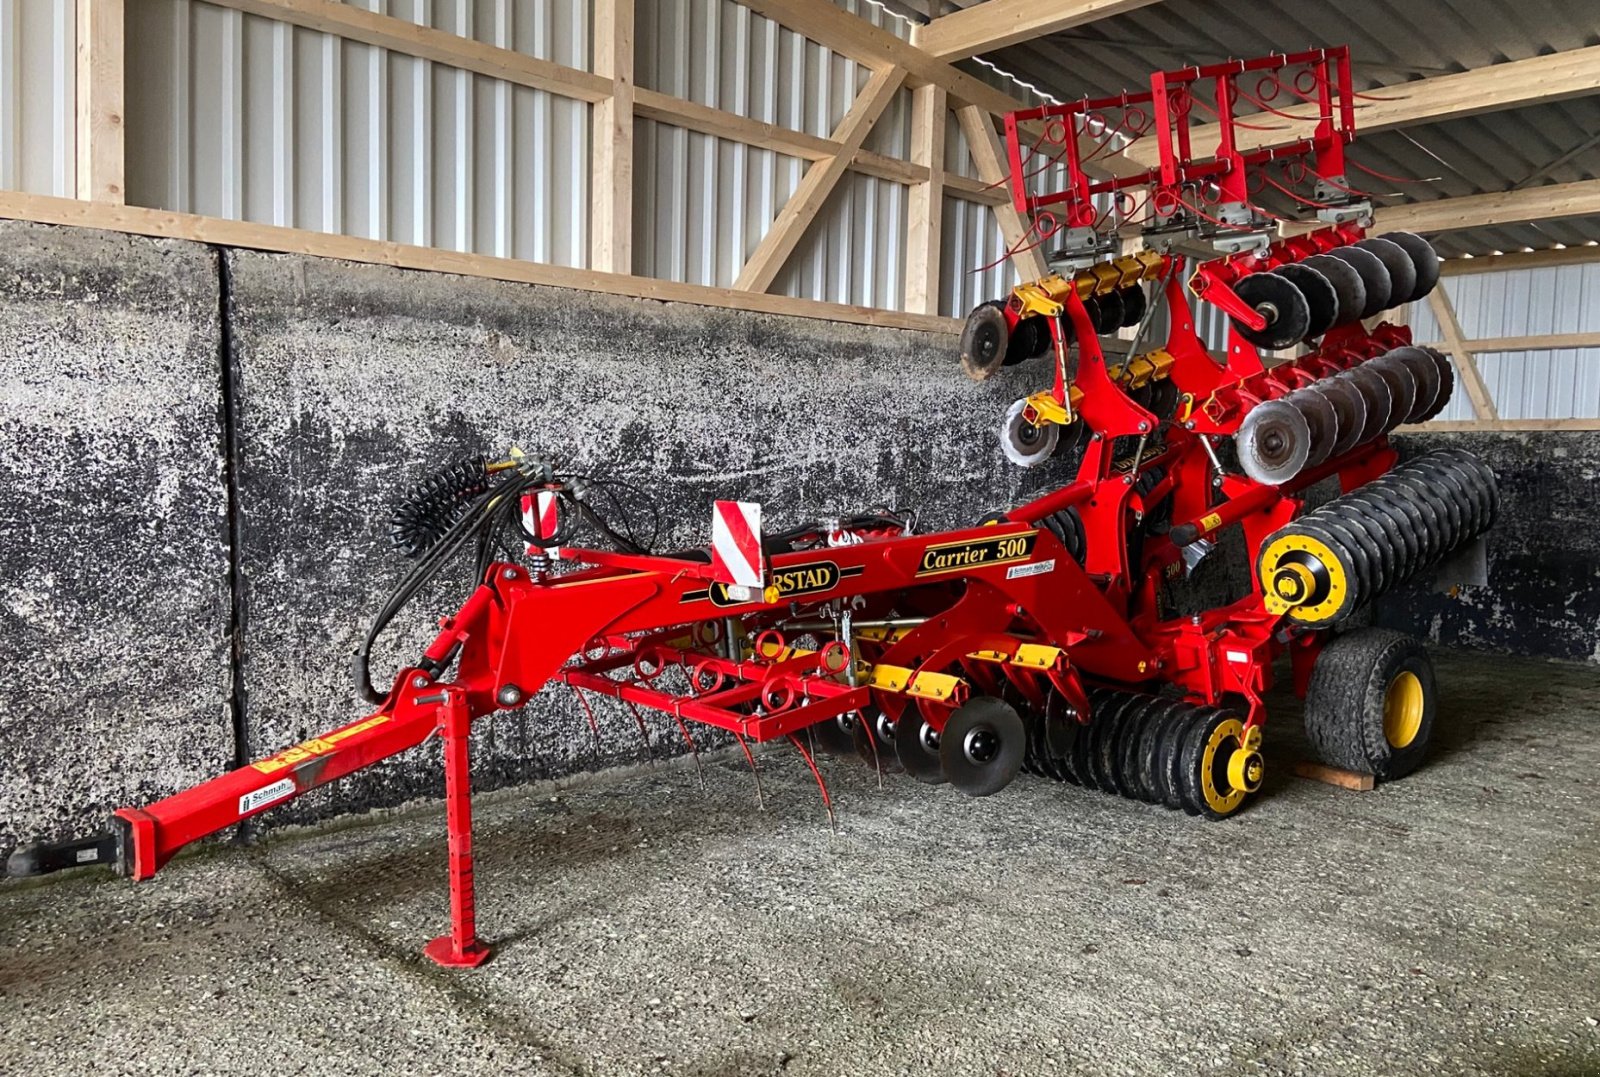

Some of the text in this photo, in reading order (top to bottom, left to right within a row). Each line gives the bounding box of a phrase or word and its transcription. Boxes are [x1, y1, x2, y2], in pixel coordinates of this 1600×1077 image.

[923, 538, 1026, 569] Carrier 500
[718, 567, 831, 601] VRSTAD
